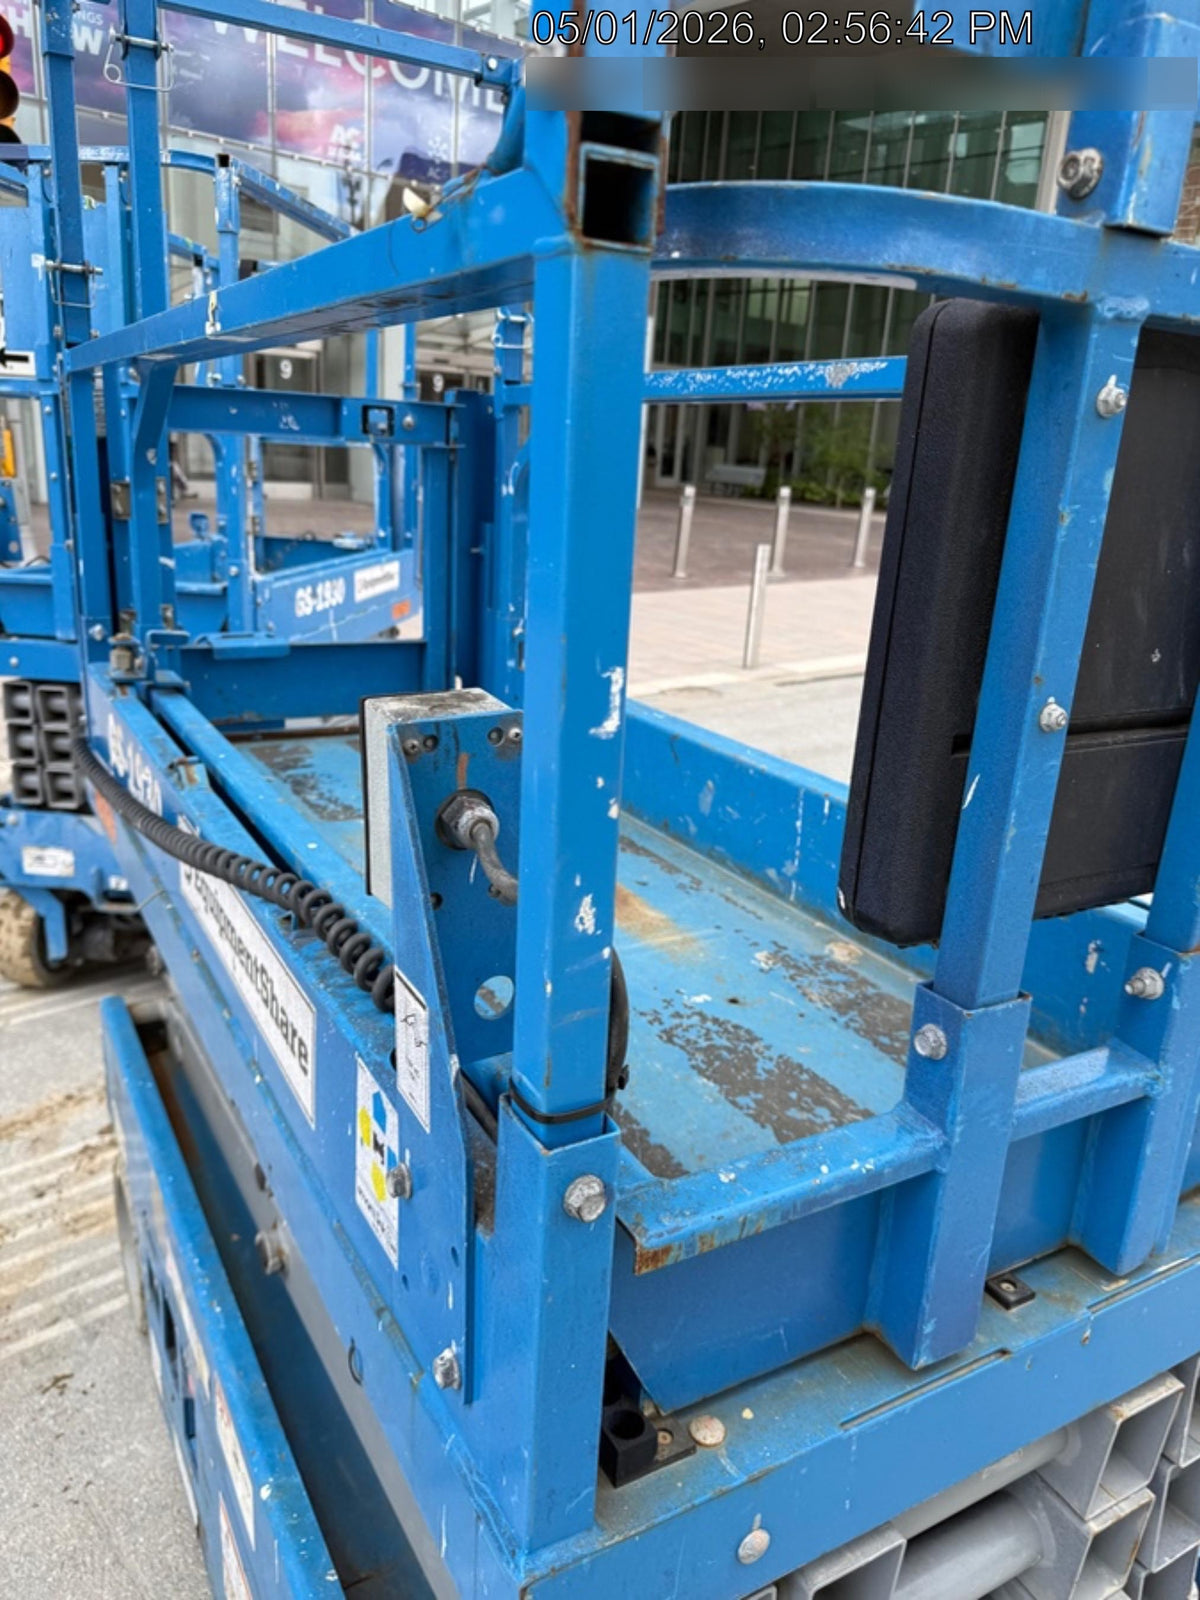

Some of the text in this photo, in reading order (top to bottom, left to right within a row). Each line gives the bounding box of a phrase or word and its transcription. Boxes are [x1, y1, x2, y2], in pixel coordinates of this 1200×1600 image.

[279, 358, 293, 380] 9
[432, 373, 445, 393] 9
[193, 868, 310, 1077] EquipmentShare
